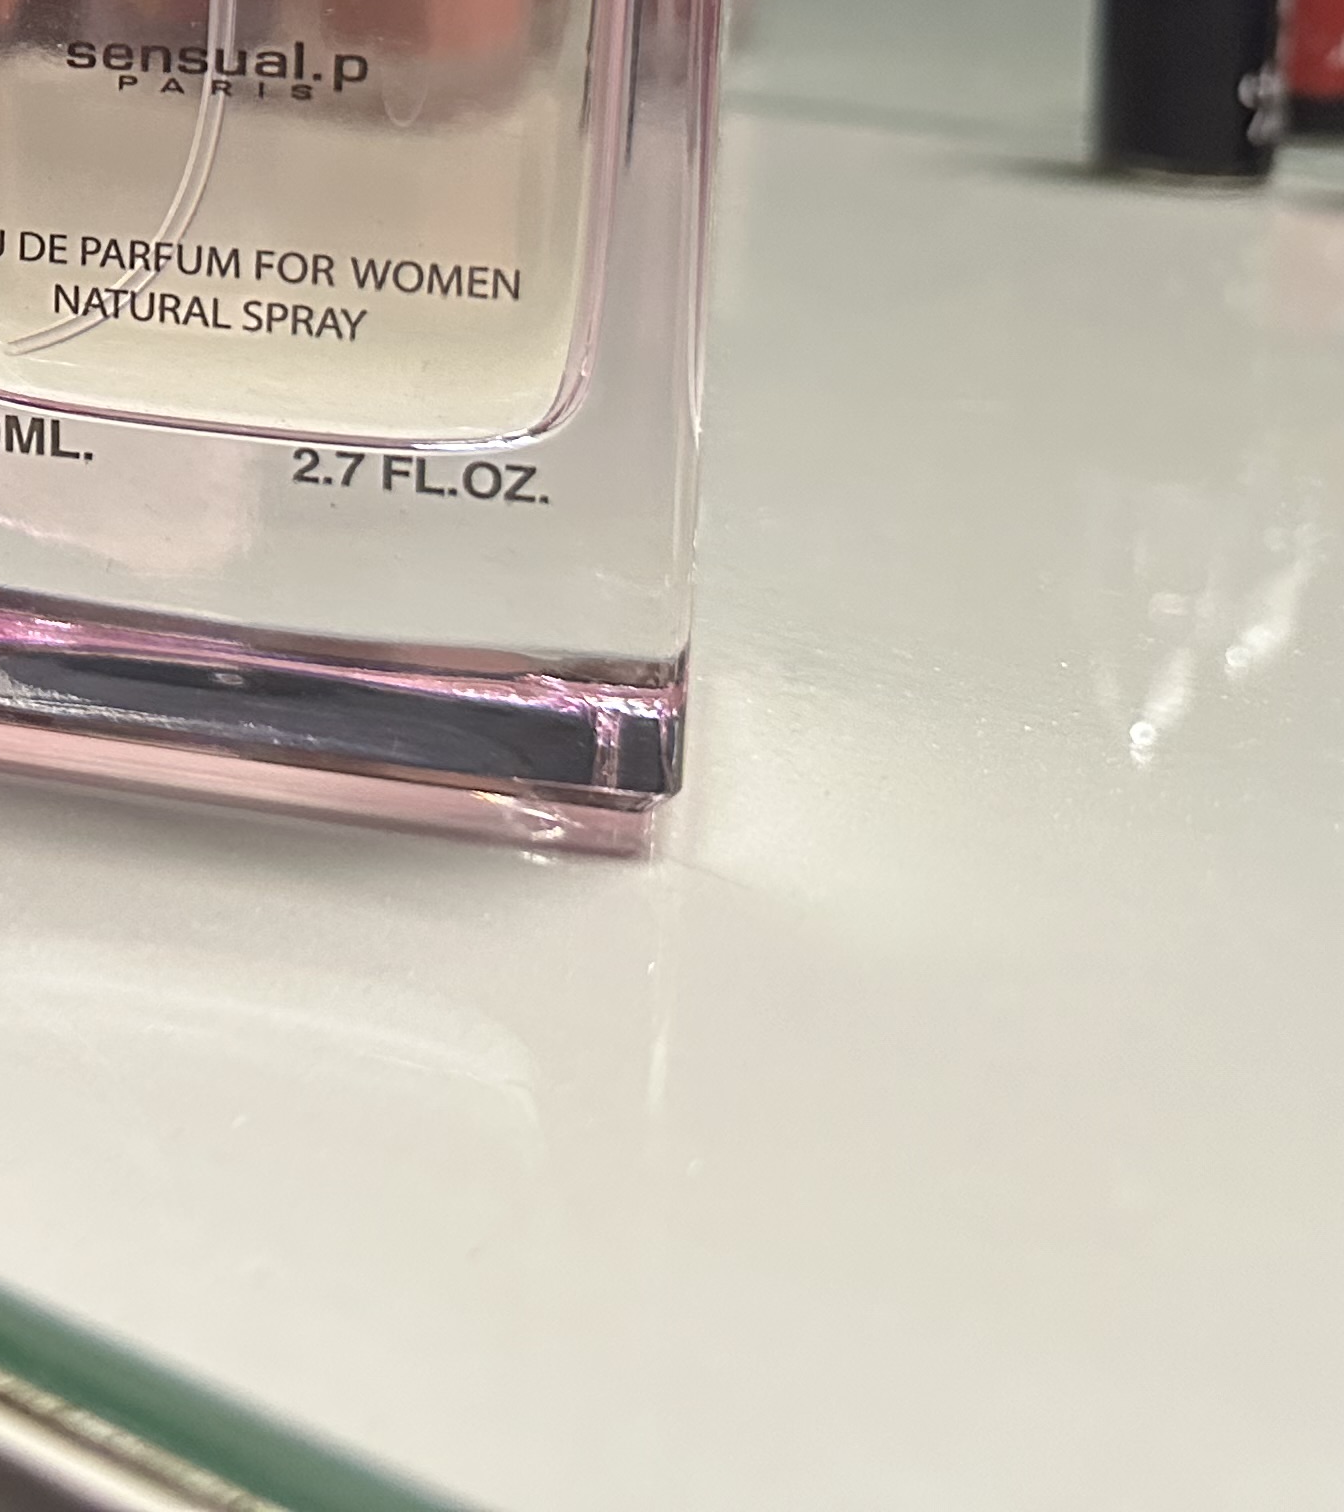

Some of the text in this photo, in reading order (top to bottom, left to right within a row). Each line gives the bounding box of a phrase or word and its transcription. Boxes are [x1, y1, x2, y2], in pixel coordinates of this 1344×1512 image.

[66, 37, 369, 92] sensual.p
[117, 75, 313, 100] PARIS
[18, 230, 68, 265] DE
[81, 236, 240, 280] PARFUM
[255, 249, 335, 287] FOR
[350, 256, 520, 301] WOMEN
[53, 284, 368, 342] NATURAL SPRAY
[292, 449, 549, 505] 2.7 FL.OZ.
